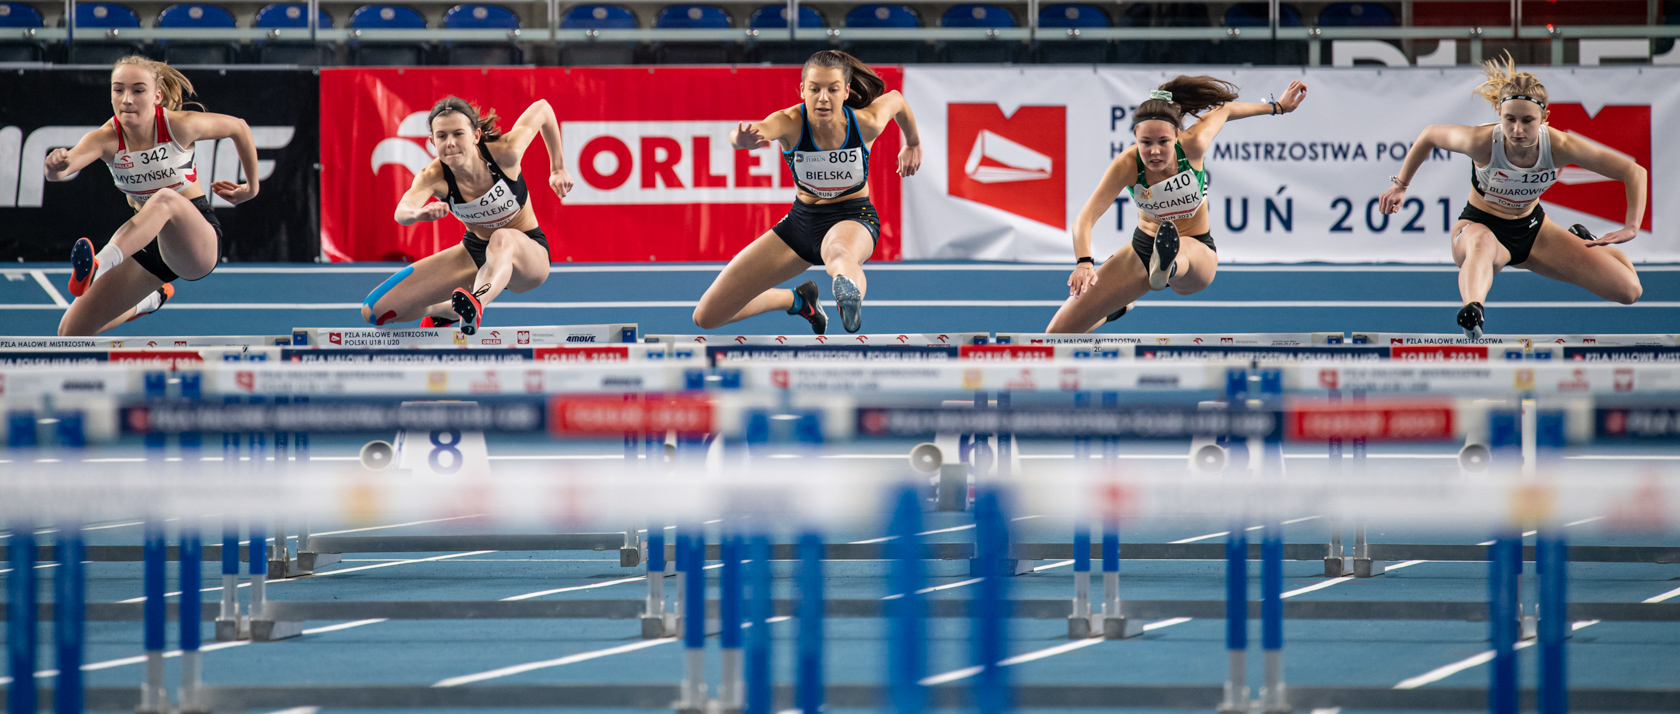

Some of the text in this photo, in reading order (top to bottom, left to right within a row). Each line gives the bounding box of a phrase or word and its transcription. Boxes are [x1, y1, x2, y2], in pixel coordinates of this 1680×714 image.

[140, 147, 169, 165] 342
[829, 150, 857, 163] 805
[1213, 142, 1452, 161] MISTRZOSTWA POKI
[115, 167, 177, 184] MYSZYŃSKA
[806, 171, 853, 180] BIELSKA
[1164, 173, 1191, 192] 410
[1521, 171, 1557, 184] 1201
[479, 185, 505, 207] 618
[1138, 191, 1200, 211] KOŚCIANEK
[1114, 185, 1451, 233] TUŃ 2021
[566, 335, 596, 343] 4MOVE
[543, 351, 621, 363] TORUŃ 2021
[968, 349, 1047, 362] TORUŃ 2021
[1401, 350, 1480, 363] TORUŃ 2021
[1611, 352, 1654, 362] HALOWE
[429, 427, 463, 475] 8
